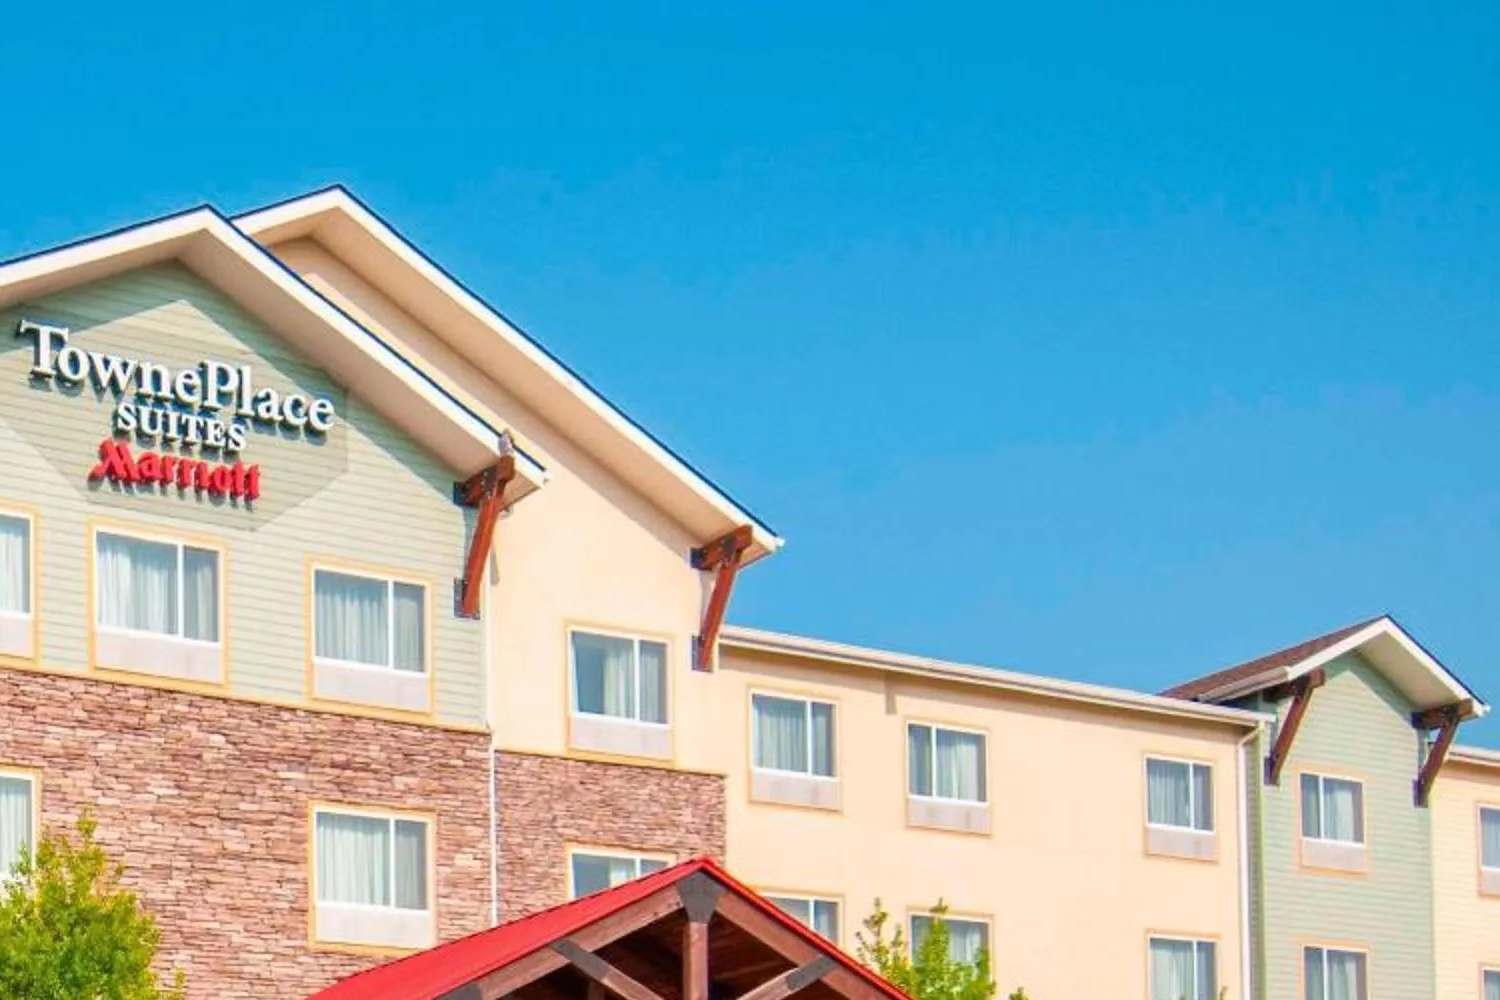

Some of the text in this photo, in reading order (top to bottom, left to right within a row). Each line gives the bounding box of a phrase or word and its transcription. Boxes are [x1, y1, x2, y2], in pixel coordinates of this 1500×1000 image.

[20, 319, 335, 431] TownePlace
[116, 400, 247, 451] SUITES
[88, 438, 261, 499] Marriott
